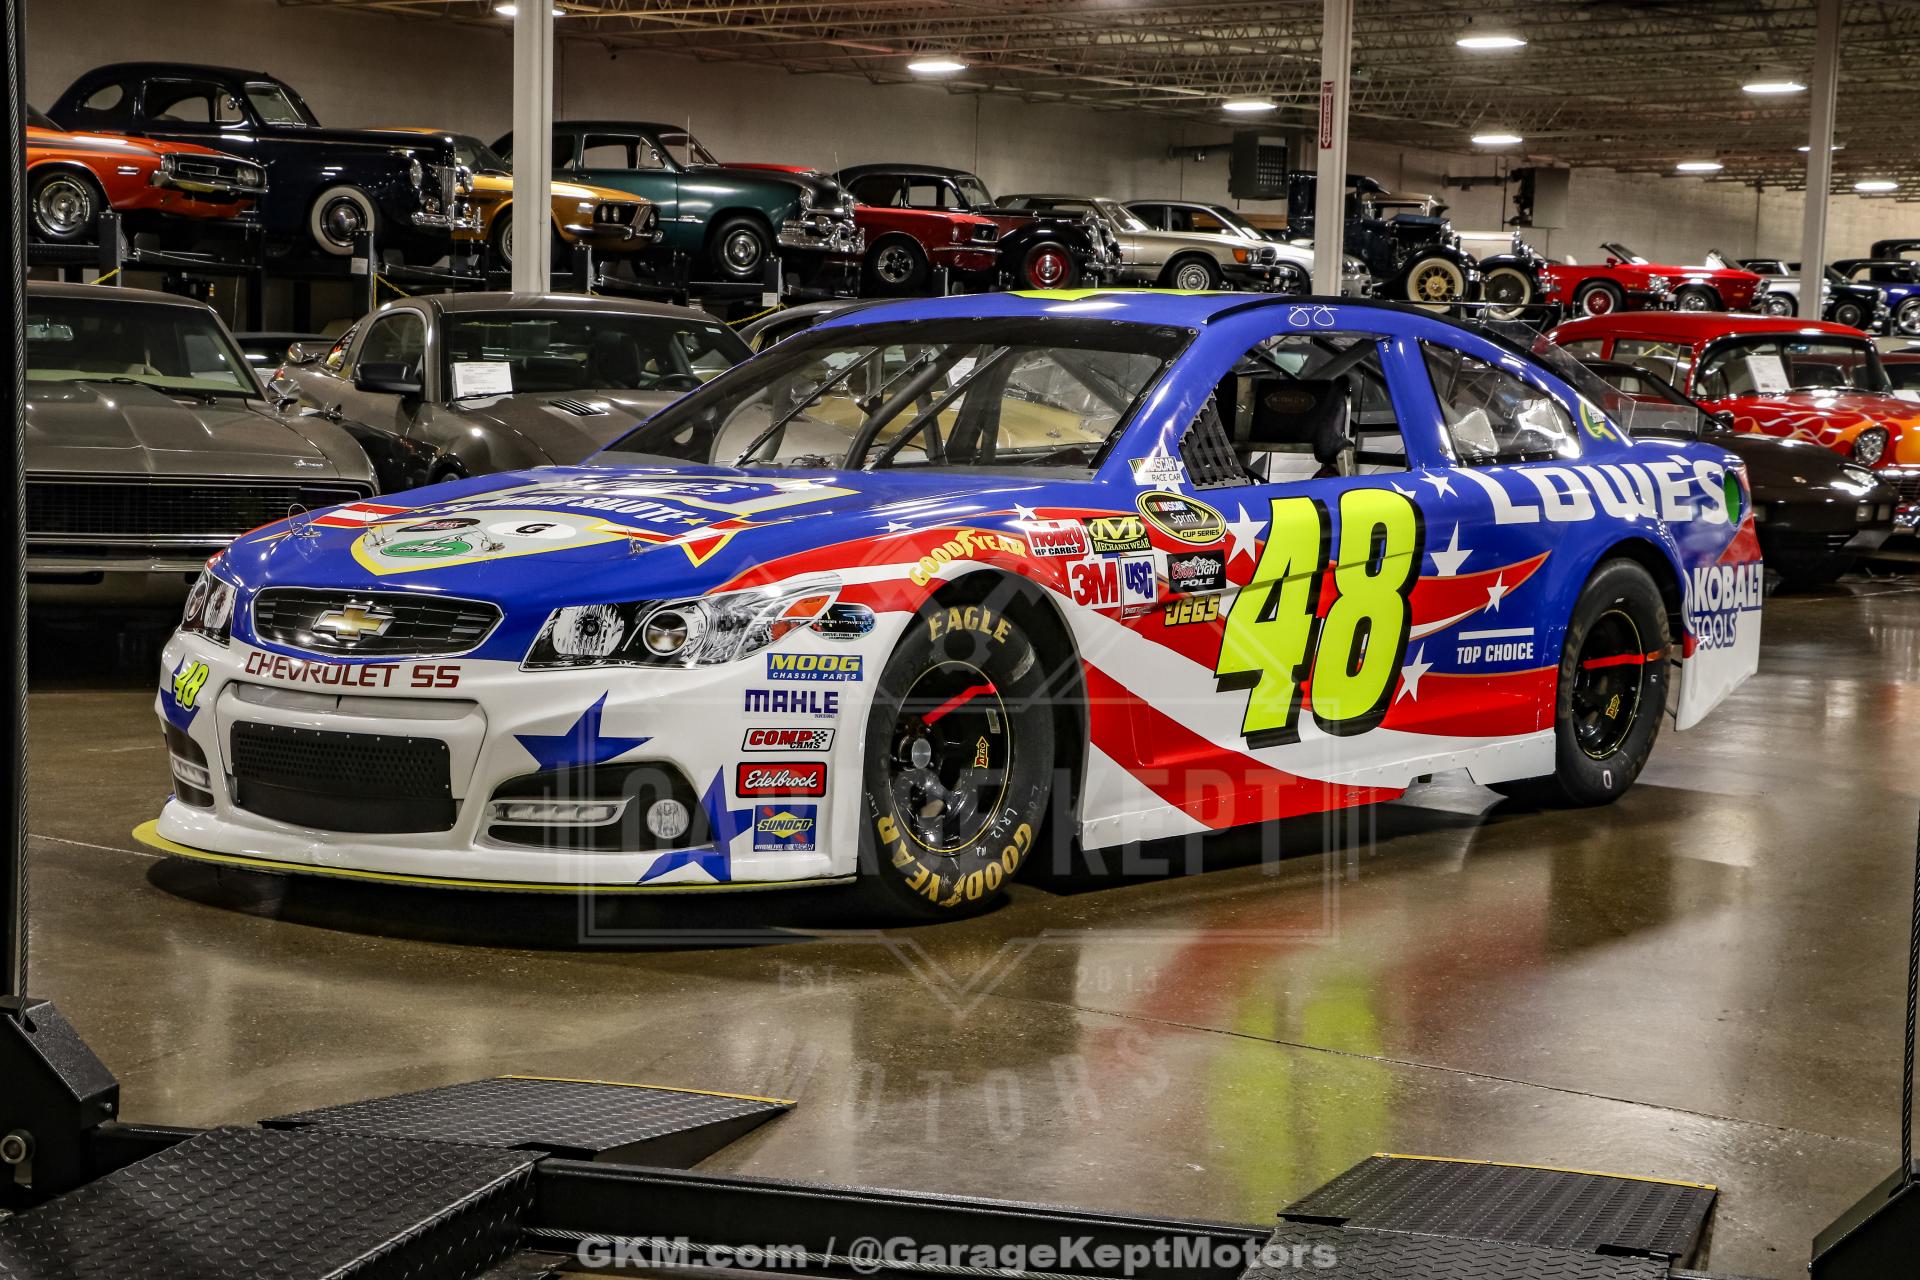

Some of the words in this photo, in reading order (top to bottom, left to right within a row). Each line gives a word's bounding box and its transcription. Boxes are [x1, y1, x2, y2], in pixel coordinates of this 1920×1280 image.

[1146, 457, 1177, 471] ASCAR
[1151, 473, 1167, 481] RACE
[1169, 473, 1181, 481] CAR
[1449, 455, 1729, 525] LOWE'S
[1170, 511, 1199, 527] Sprint
[1182, 530, 1196, 538] CUP
[1197, 529, 1220, 537] SERIES
[1048, 546, 1078, 555] CARBS
[1094, 541, 1131, 552] MECHANIX
[1130, 537, 1151, 549] WEAR
[909, 529, 1027, 586] GOODYEAR
[1124, 561, 1154, 599] USG
[1171, 562, 1197, 580] Coors
[1196, 564, 1222, 576] LIGHT
[1071, 561, 1119, 606] 3M
[1180, 577, 1216, 587] POLE
[1164, 594, 1221, 627] JEGS
[1213, 488, 1425, 750] 48
[928, 605, 1012, 644] EAGLE
[1694, 612, 1738, 649] TOOLS
[770, 655, 860, 671] MOOG
[1456, 646, 1482, 665] TOP
[1485, 642, 1534, 662] CHOICE
[244, 651, 400, 688] CHEVROLET
[410, 665, 461, 688] SS
[174, 660, 210, 710] 48
[744, 689, 839, 714] MAHLE
[749, 730, 814, 746] COMP
[789, 741, 822, 749] CAMS
[744, 769, 818, 789] Edelbrock
[758, 820, 810, 831] SUNOCO
[877, 811, 1033, 907] GOODYEAR
